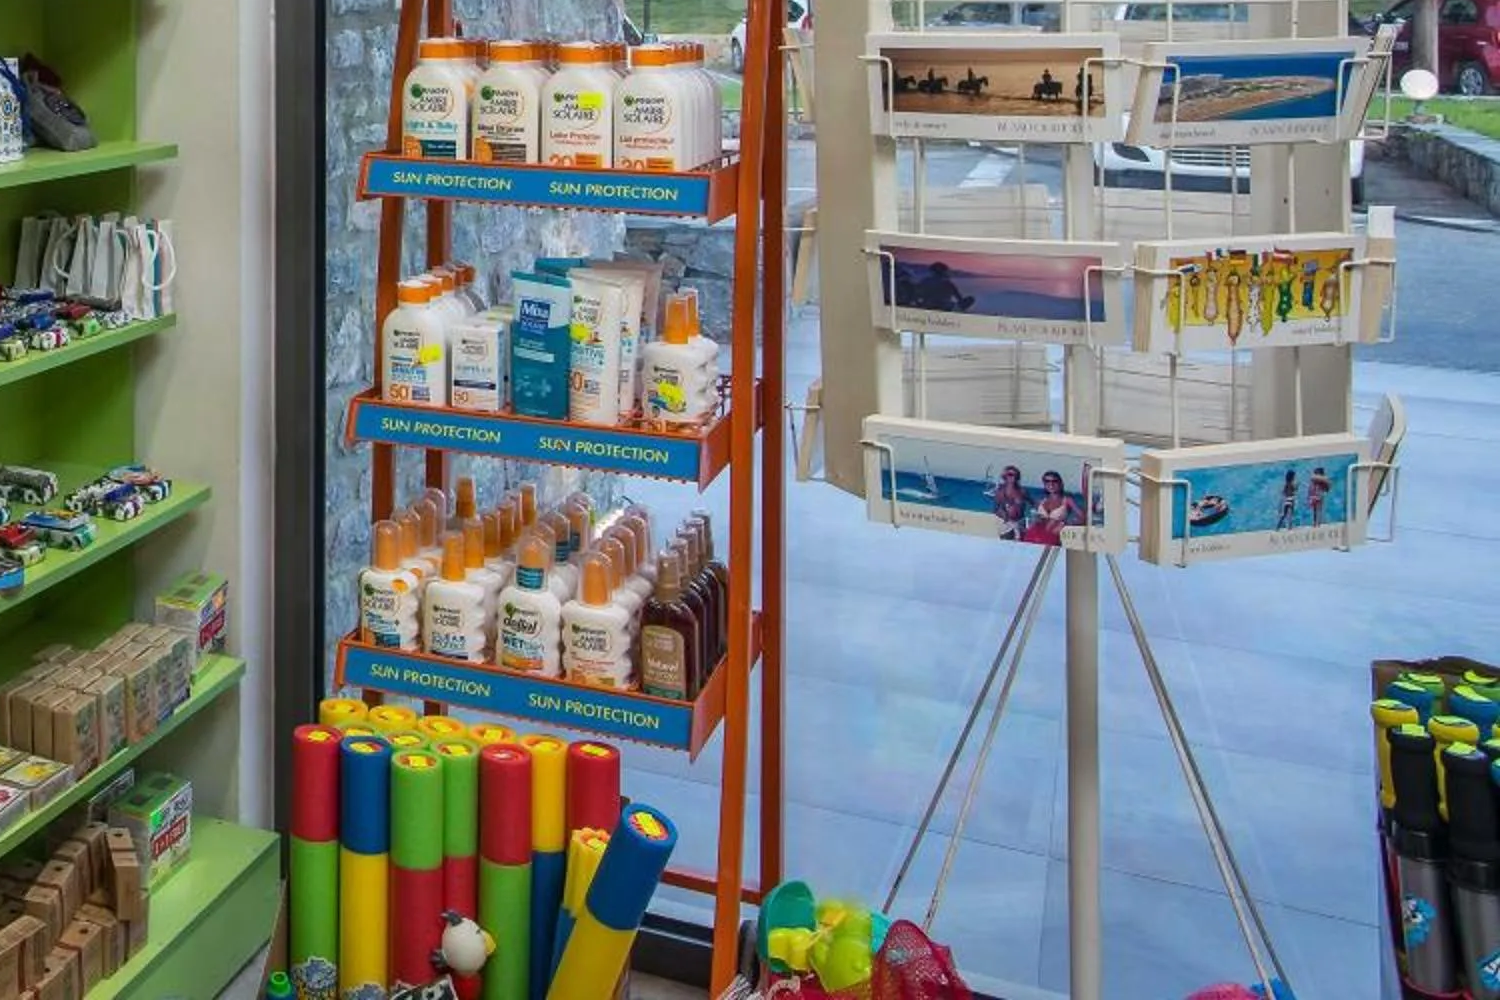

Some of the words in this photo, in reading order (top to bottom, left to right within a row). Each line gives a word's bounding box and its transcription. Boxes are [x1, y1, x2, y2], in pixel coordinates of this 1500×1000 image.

[393, 172, 422, 185] SUN
[426, 175, 512, 191] PROTECTION
[549, 181, 582, 196] SUN
[585, 184, 678, 201] PROTECTION
[389, 384, 409, 399] 50
[381, 417, 410, 431] SUN
[414, 422, 501, 443] PROTECTION
[539, 436, 571, 451] SUN
[575, 439, 669, 464] PROTECTION
[370, 663, 400, 680] SUN
[403, 669, 491, 697] PROTECTION
[528, 693, 564, 710] SUN
[566, 698, 660, 730] PROTECTION
